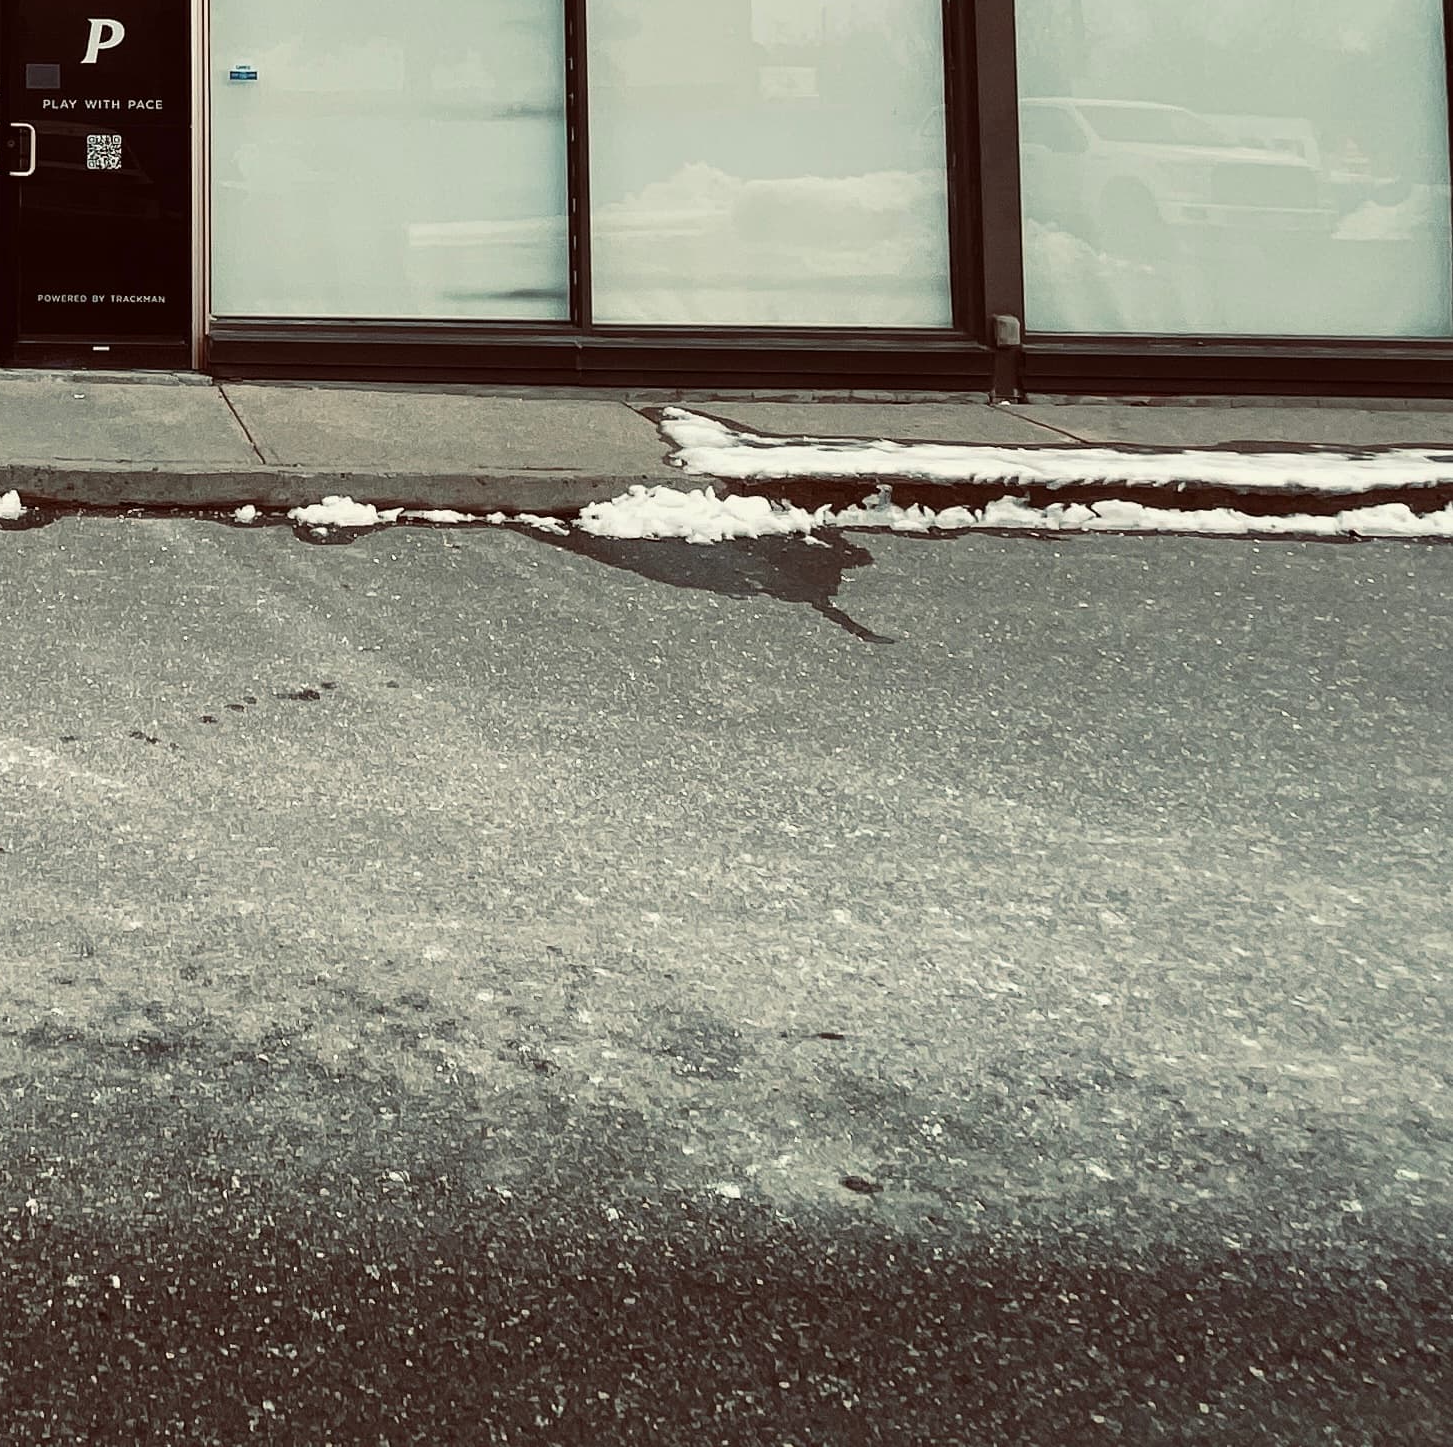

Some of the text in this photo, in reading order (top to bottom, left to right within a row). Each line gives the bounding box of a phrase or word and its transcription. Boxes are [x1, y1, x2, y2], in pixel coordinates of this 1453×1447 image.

[80, 18, 126, 64] P
[42, 98, 163, 110] PLAY WITH PACE
[37, 294, 166, 304] POWERED BY TRACKMAN
